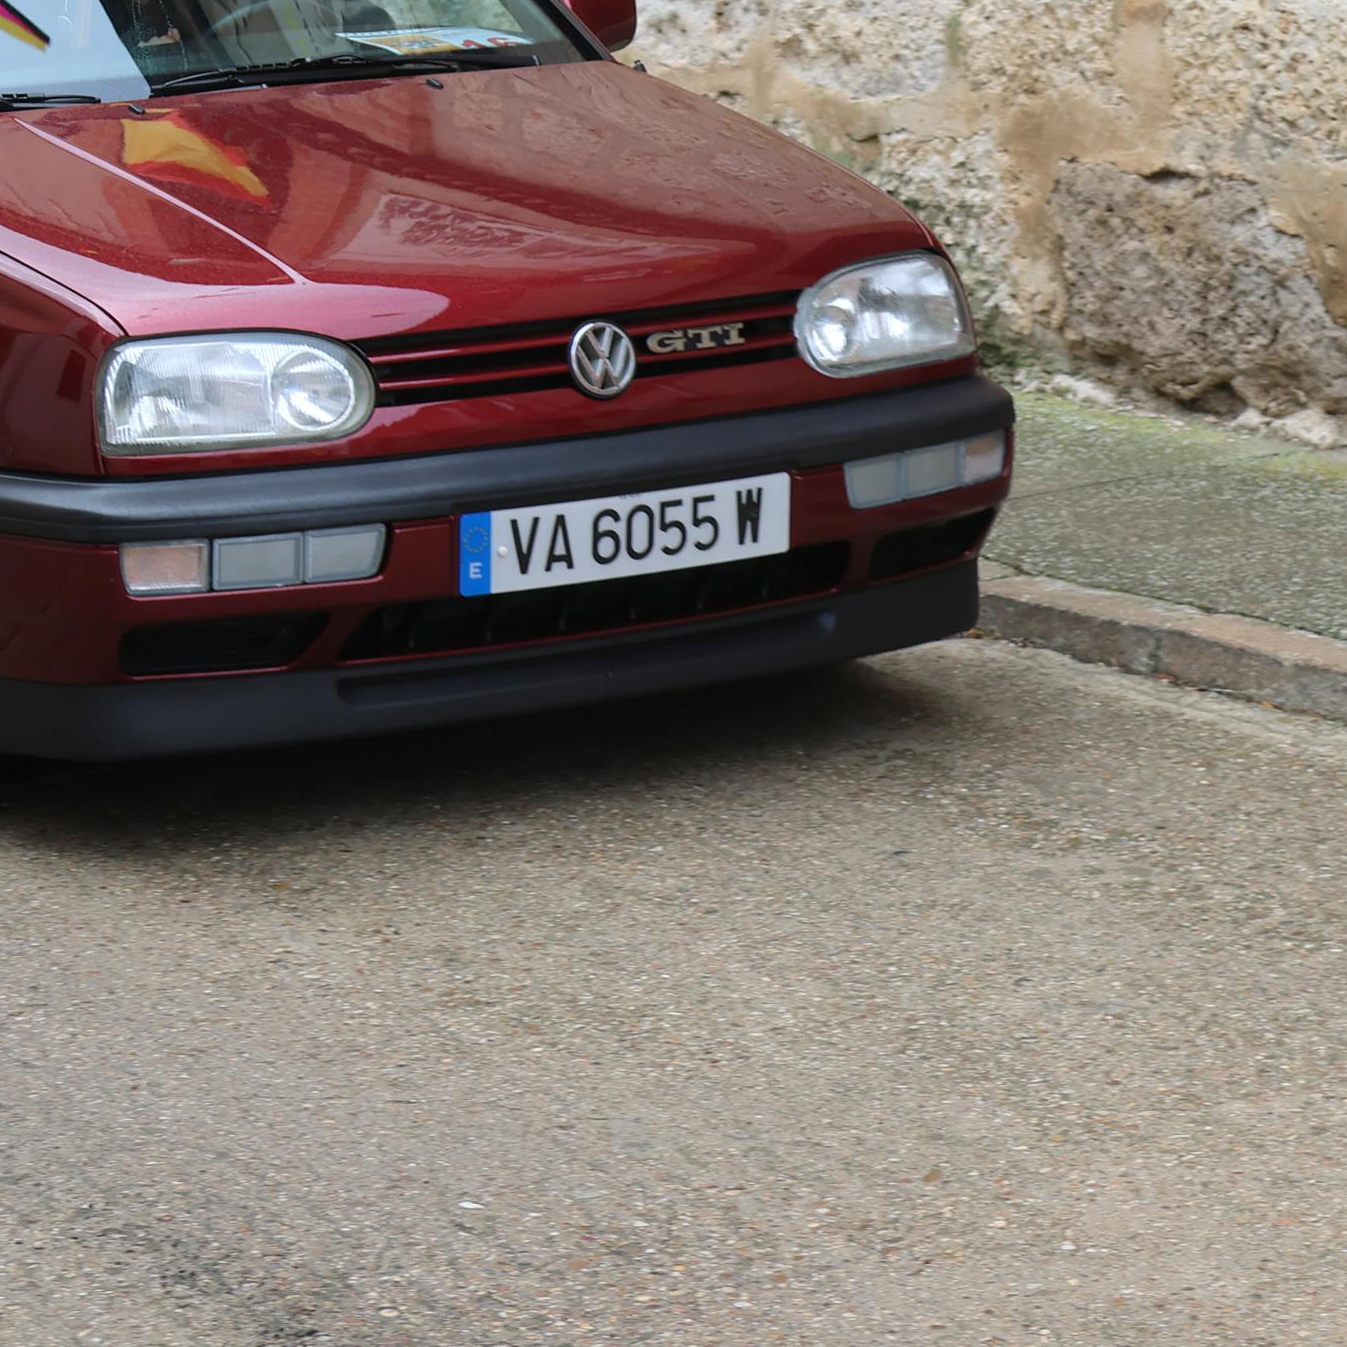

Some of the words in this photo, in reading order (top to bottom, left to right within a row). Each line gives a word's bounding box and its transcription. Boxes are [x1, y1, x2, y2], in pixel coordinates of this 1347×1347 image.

[647, 322, 745, 353] GTI
[510, 513, 574, 575] VA
[592, 494, 719, 565] 6055
[736, 487, 763, 546] W
[468, 562, 483, 580] E
